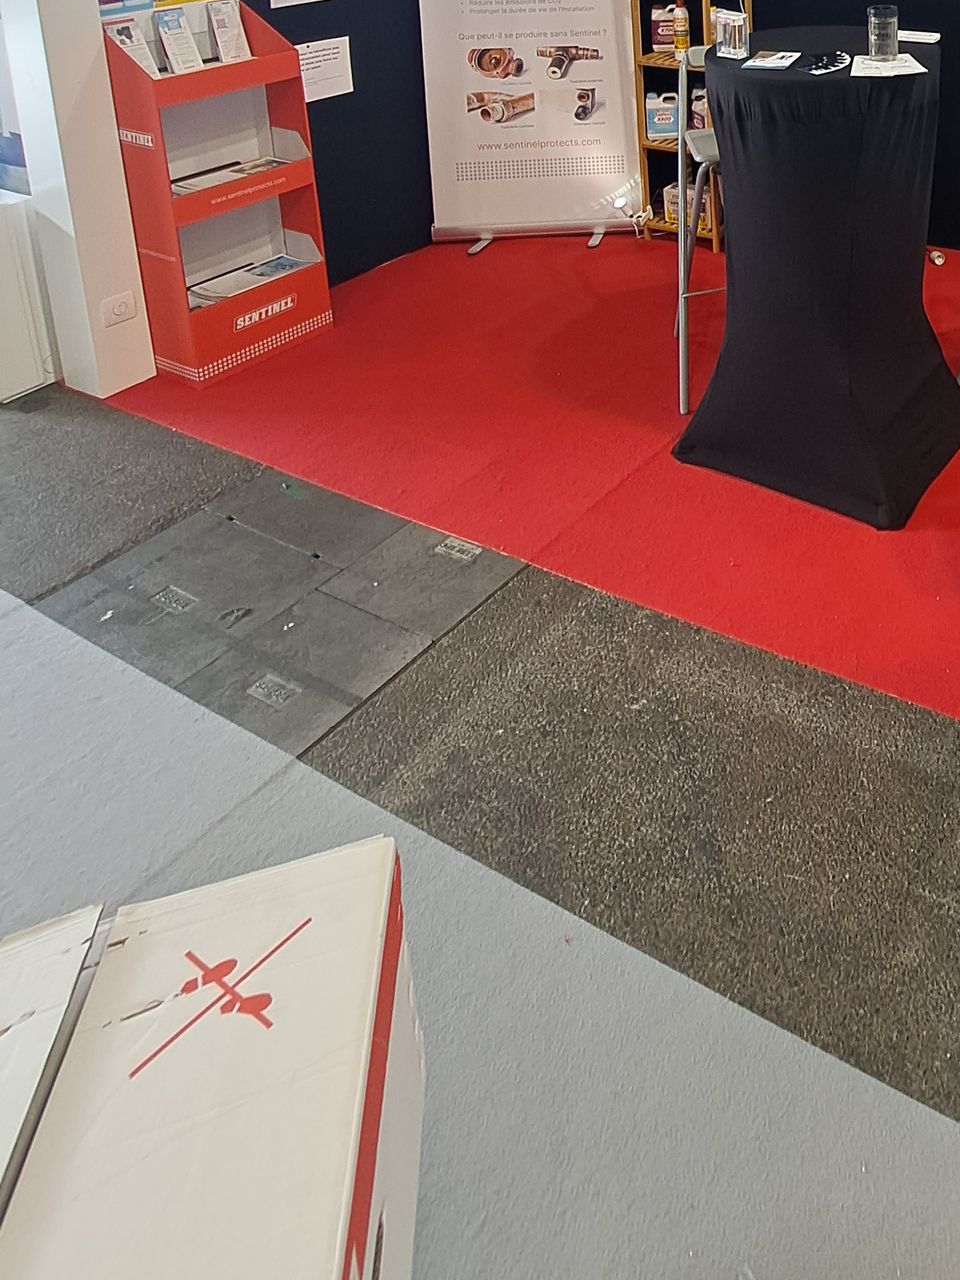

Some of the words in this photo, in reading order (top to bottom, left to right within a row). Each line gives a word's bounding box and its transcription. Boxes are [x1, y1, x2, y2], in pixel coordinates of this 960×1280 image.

[458, 33, 475, 41] Que
[477, 31, 502, 41] peut-il
[515, 31, 548, 40] produire
[569, 29, 601, 37] Sentinel
[476, 137, 602, 151] www.sentinelprotects.com
[236, 296, 294, 330] SENTINEL
